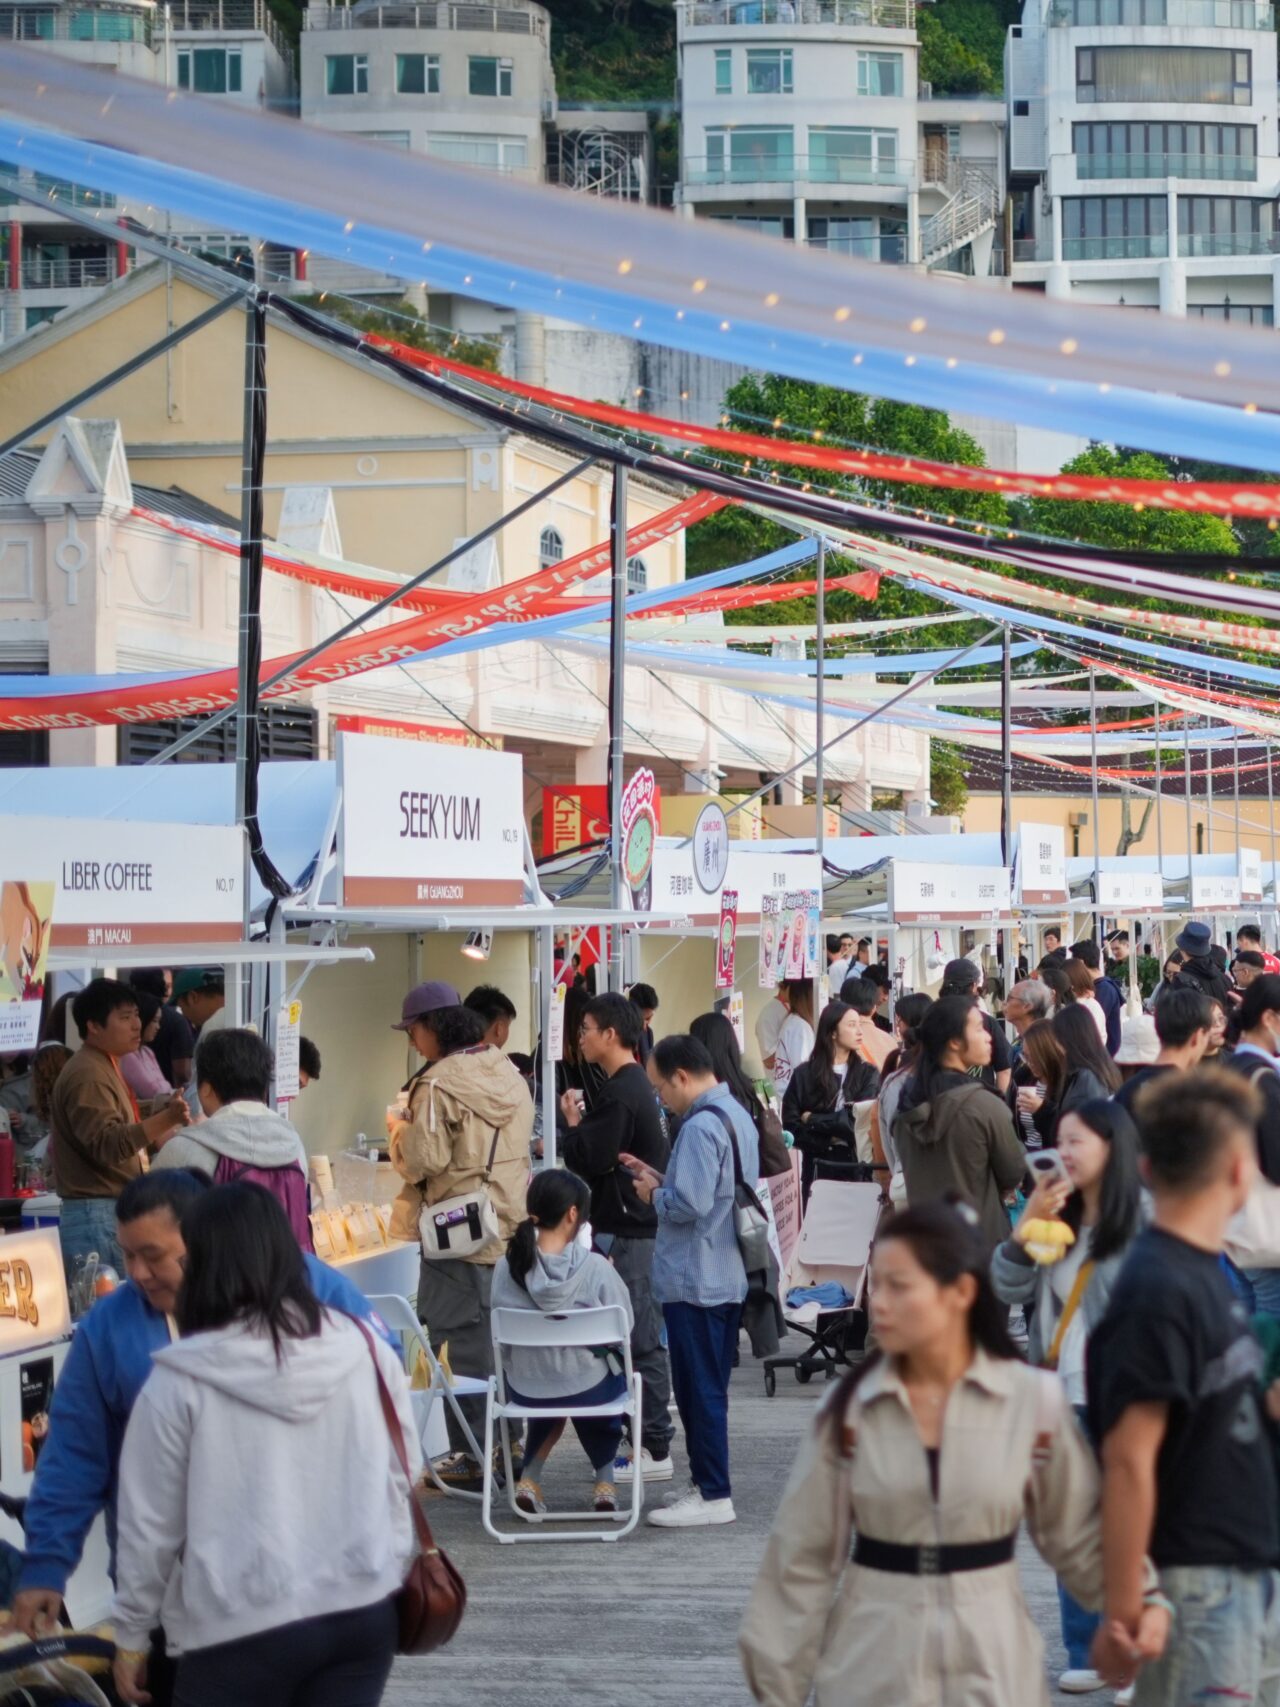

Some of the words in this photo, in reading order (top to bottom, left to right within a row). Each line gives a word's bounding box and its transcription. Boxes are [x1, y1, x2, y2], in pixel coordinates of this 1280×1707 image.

[399, 791, 480, 841] SEEKYUM
[62, 861, 100, 891] LIBER
[104, 862, 152, 892] COFFEE
[430, 885, 464, 899] GUANGZHOU
[87, 928, 103, 945] 澳門
[104, 929, 131, 944] MACAU
